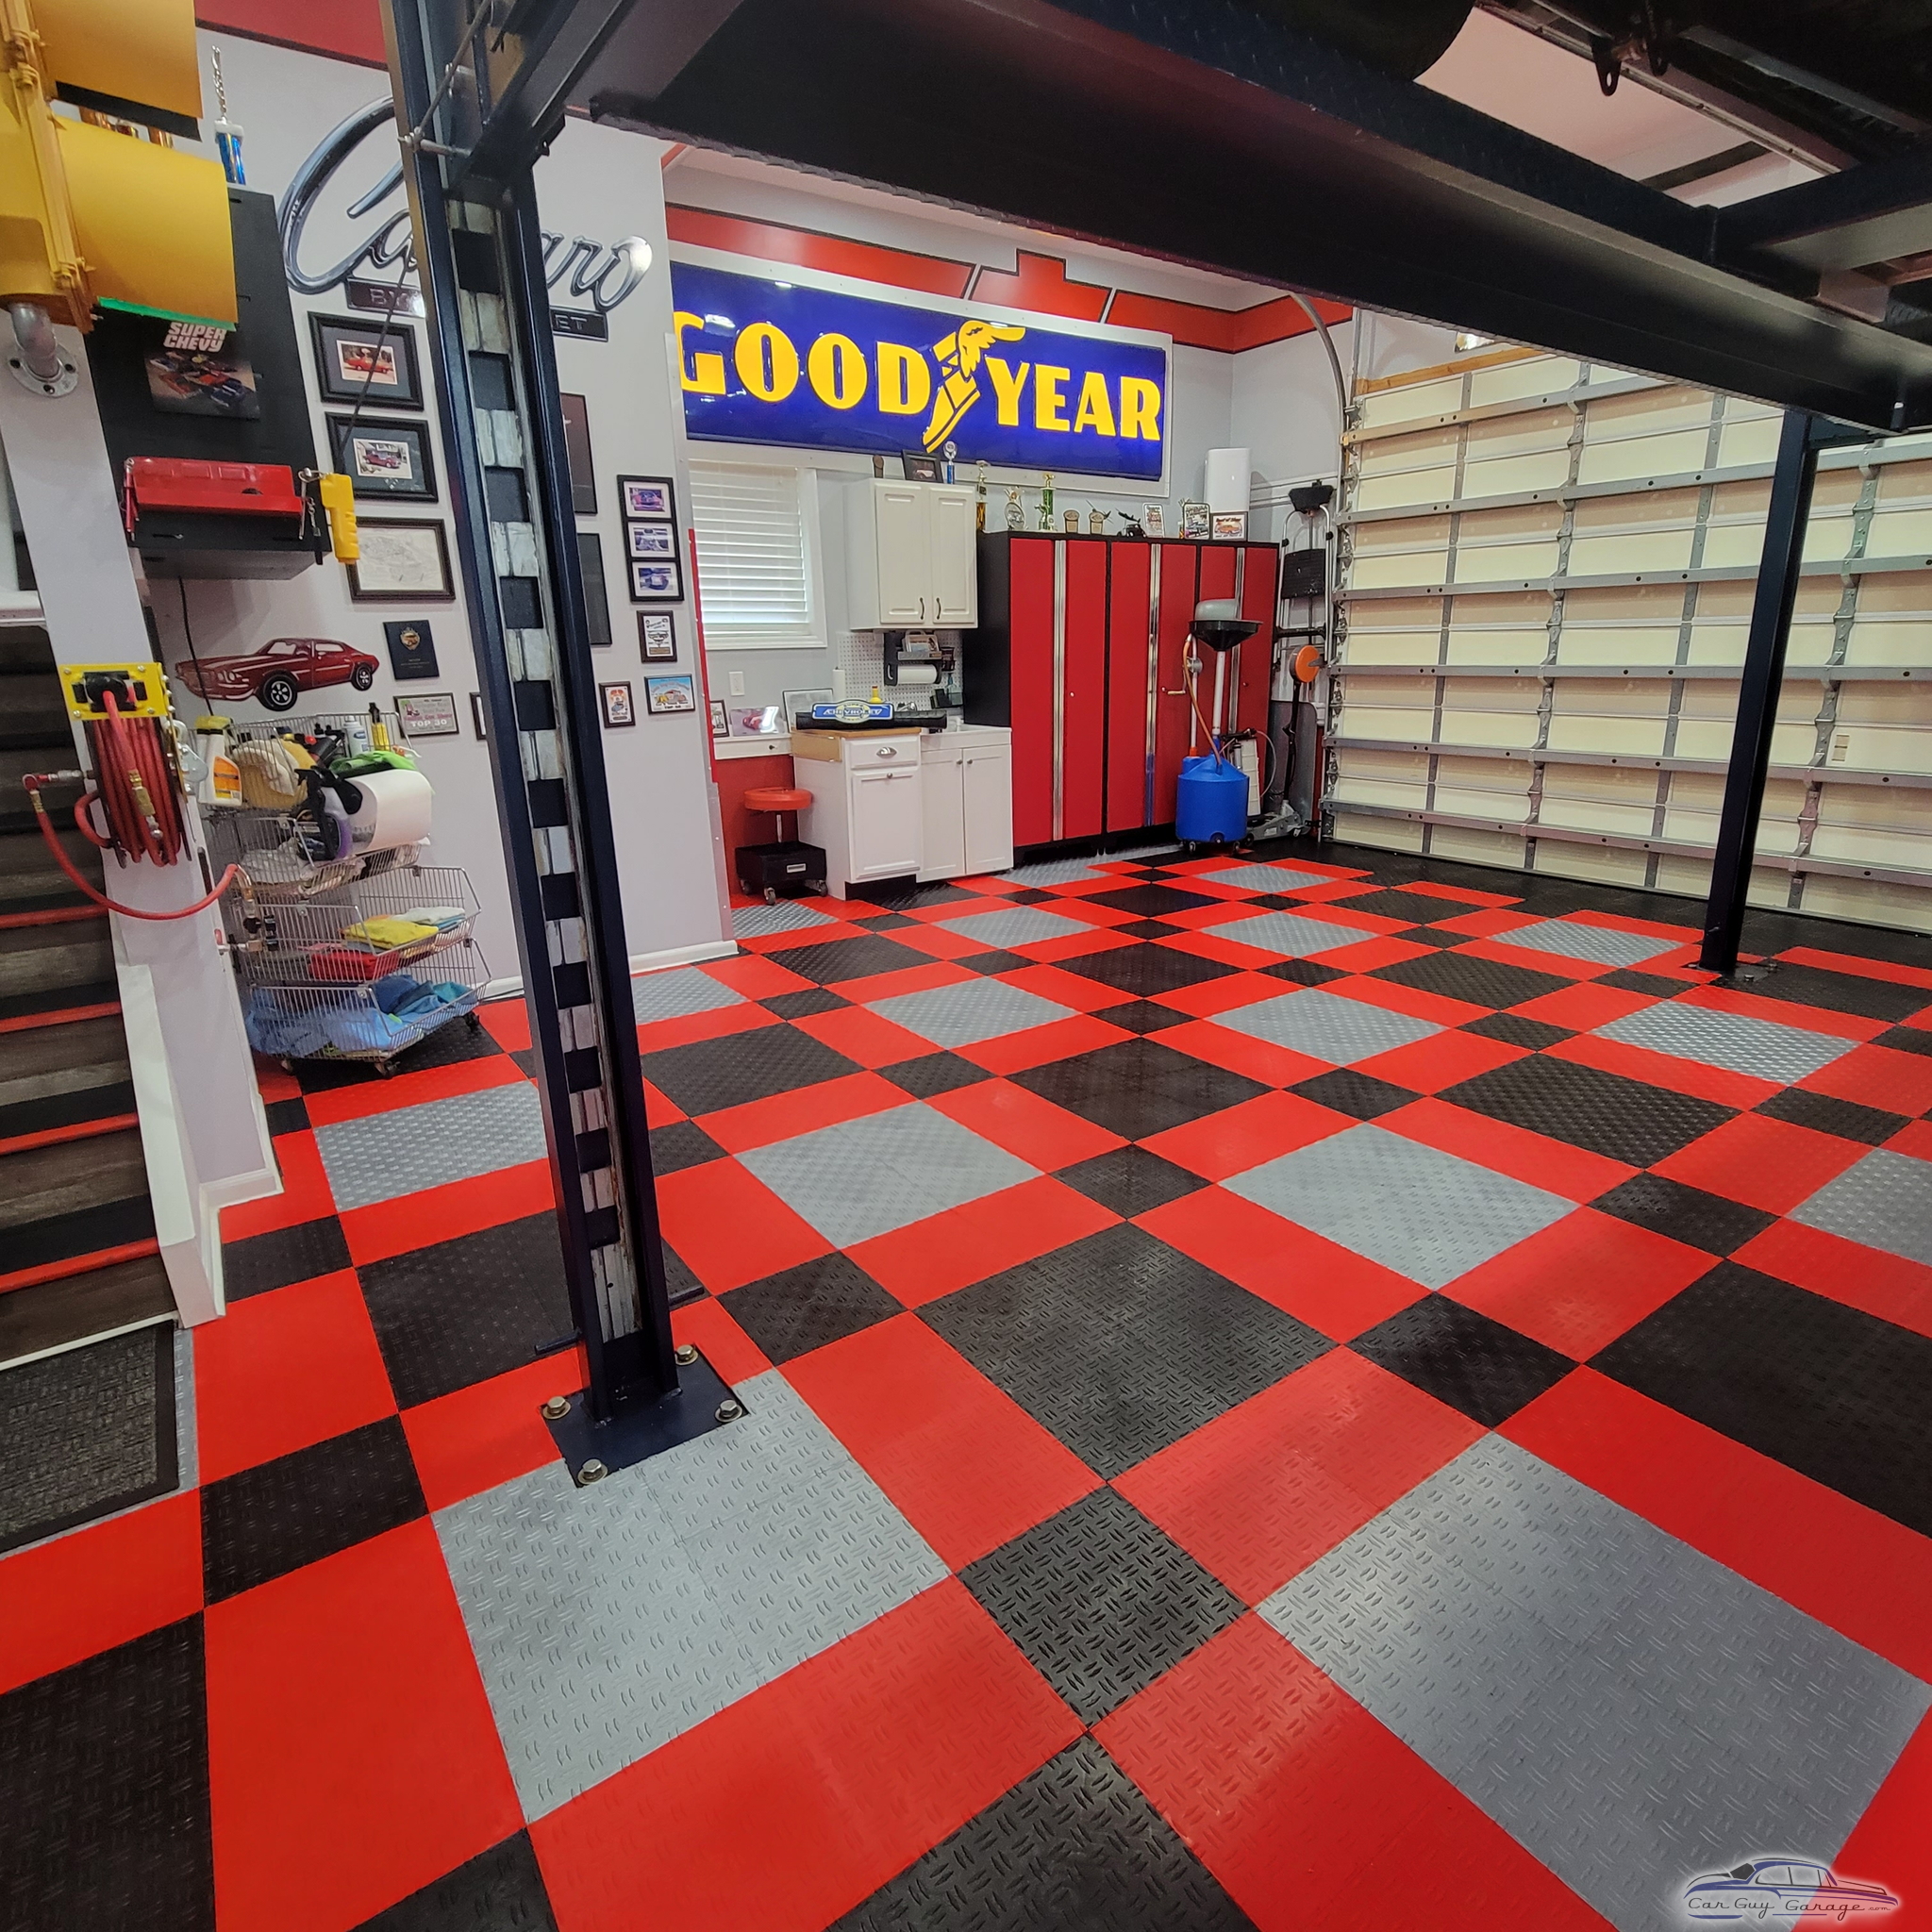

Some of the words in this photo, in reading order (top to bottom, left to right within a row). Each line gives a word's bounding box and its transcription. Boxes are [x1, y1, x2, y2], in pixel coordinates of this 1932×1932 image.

[277, 95, 653, 312] Caro
[168, 322, 227, 340] SUPER
[163, 334, 225, 353] CHEVY
